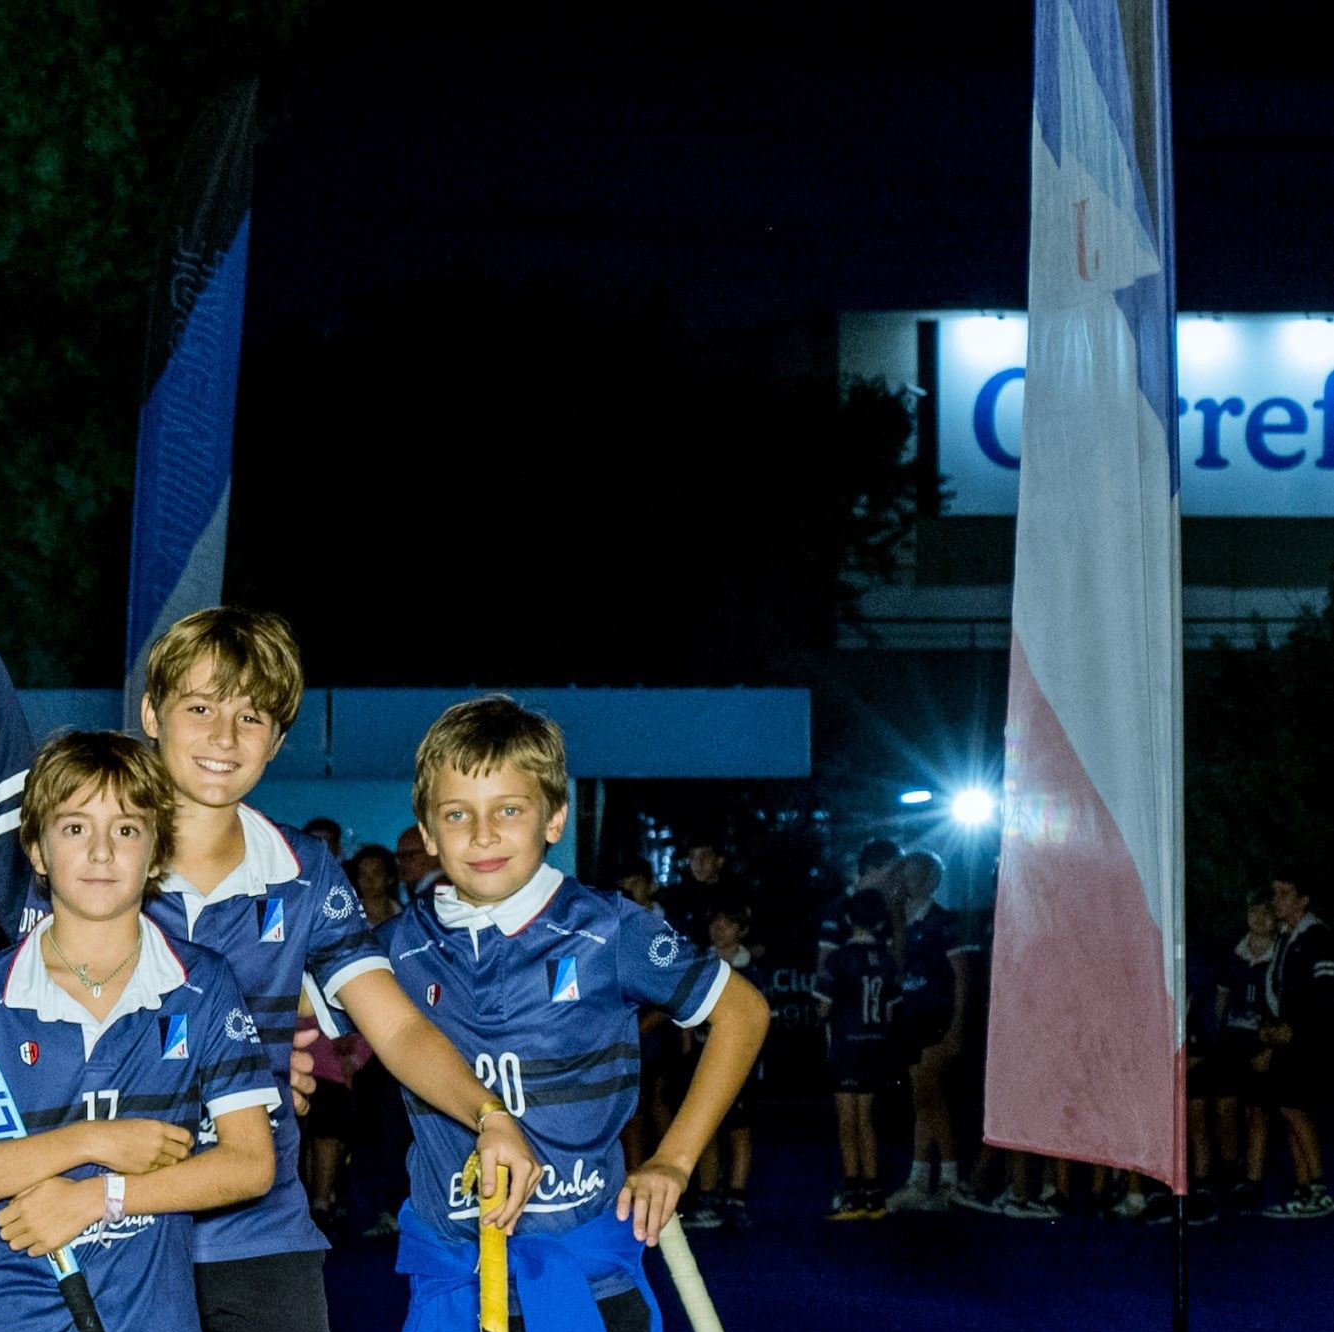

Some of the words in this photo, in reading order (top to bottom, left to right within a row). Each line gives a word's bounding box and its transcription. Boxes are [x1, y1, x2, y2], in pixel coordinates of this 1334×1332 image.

[973, 367, 1334, 470] Cre
[772, 966, 820, 993] Clu
[81, 1088, 119, 1122] 17
[475, 1051, 526, 1118] 20
[535, 1157, 606, 1202] Cuba
